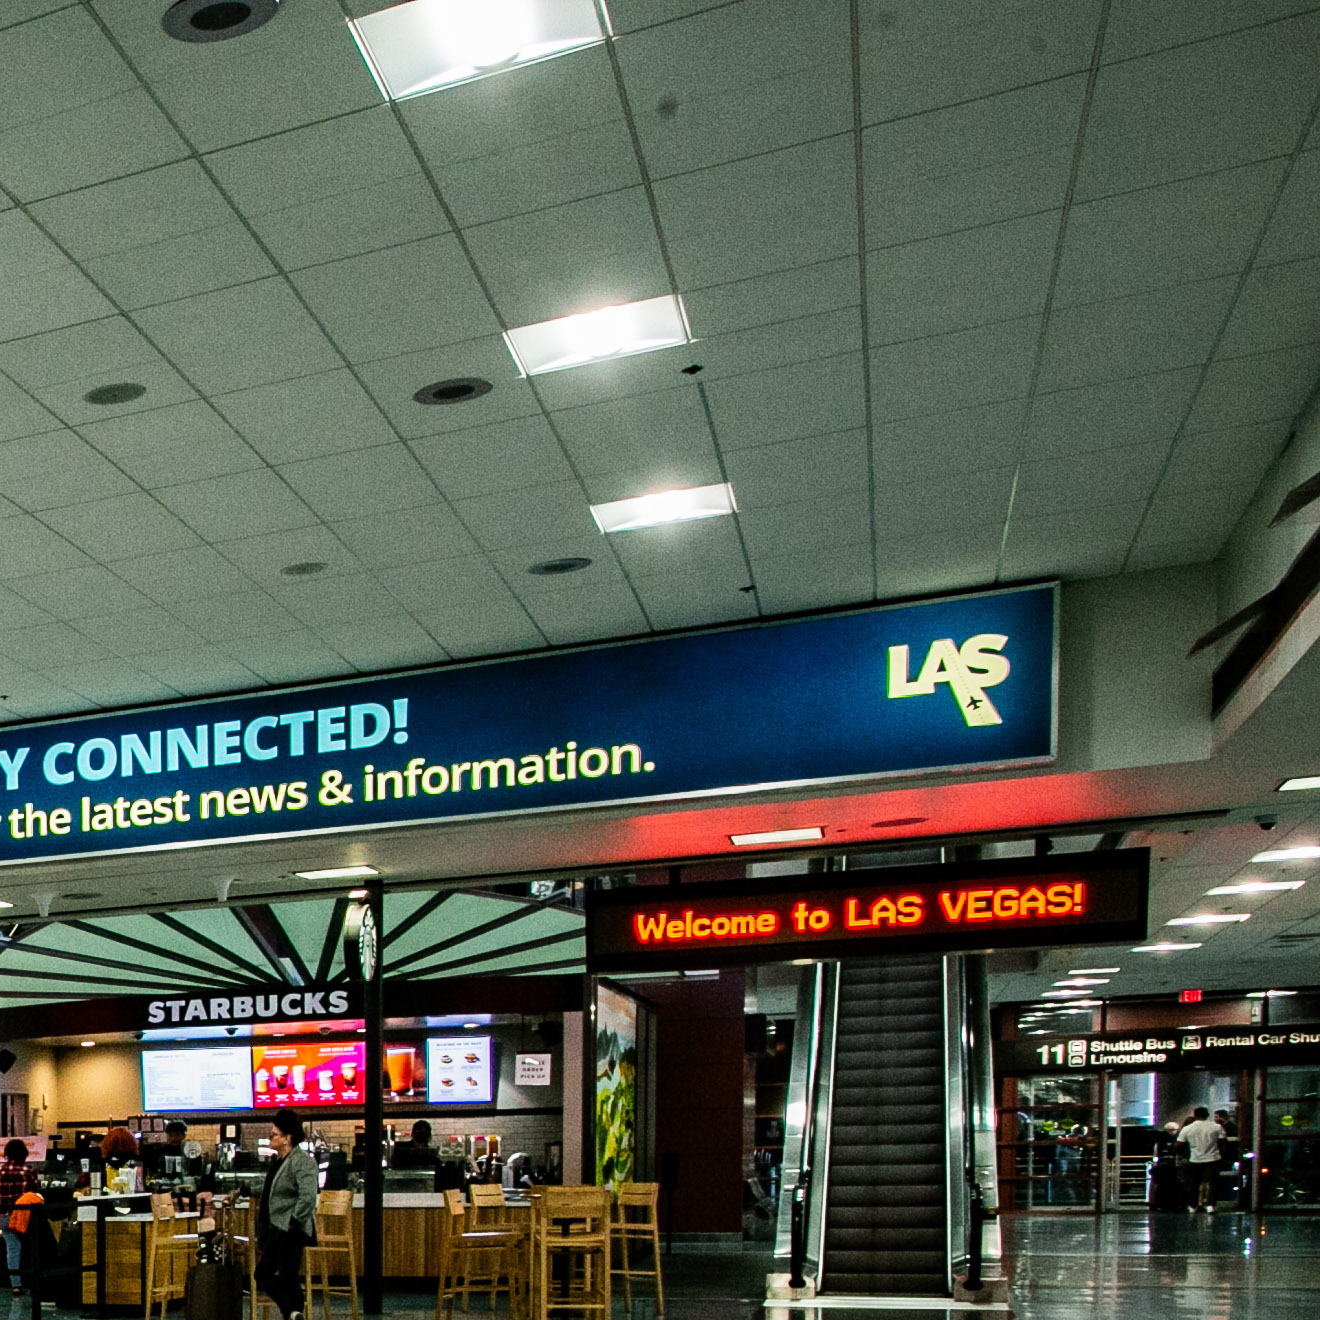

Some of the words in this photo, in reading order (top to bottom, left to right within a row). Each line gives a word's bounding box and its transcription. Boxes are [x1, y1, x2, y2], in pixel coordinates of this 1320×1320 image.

[887, 634, 1010, 727] LAS
[42, 698, 410, 786] CONNECTED!
[9, 803, 71, 839] the
[80, 790, 191, 832] latest
[199, 779, 309, 819] news
[318, 769, 354, 807] &
[363, 741, 656, 803] information.
[636, 911, 776, 942] Welcome
[794, 902, 830, 932] to
[846, 895, 922, 927] LAS
[942, 883, 1085, 921] VEGAS!
[148, 990, 349, 1024] STARBUCKS
[1183, 991, 1201, 1002] EXIT
[1090, 1040, 1143, 1053] Shuttle
[1146, 1038, 1176, 1050] Bus
[1206, 1034, 1254, 1047] Rental
[1257, 1034, 1286, 1045] Car
[1037, 1044, 1065, 1065] 11
[1090, 1052, 1167, 1065] Limousine
